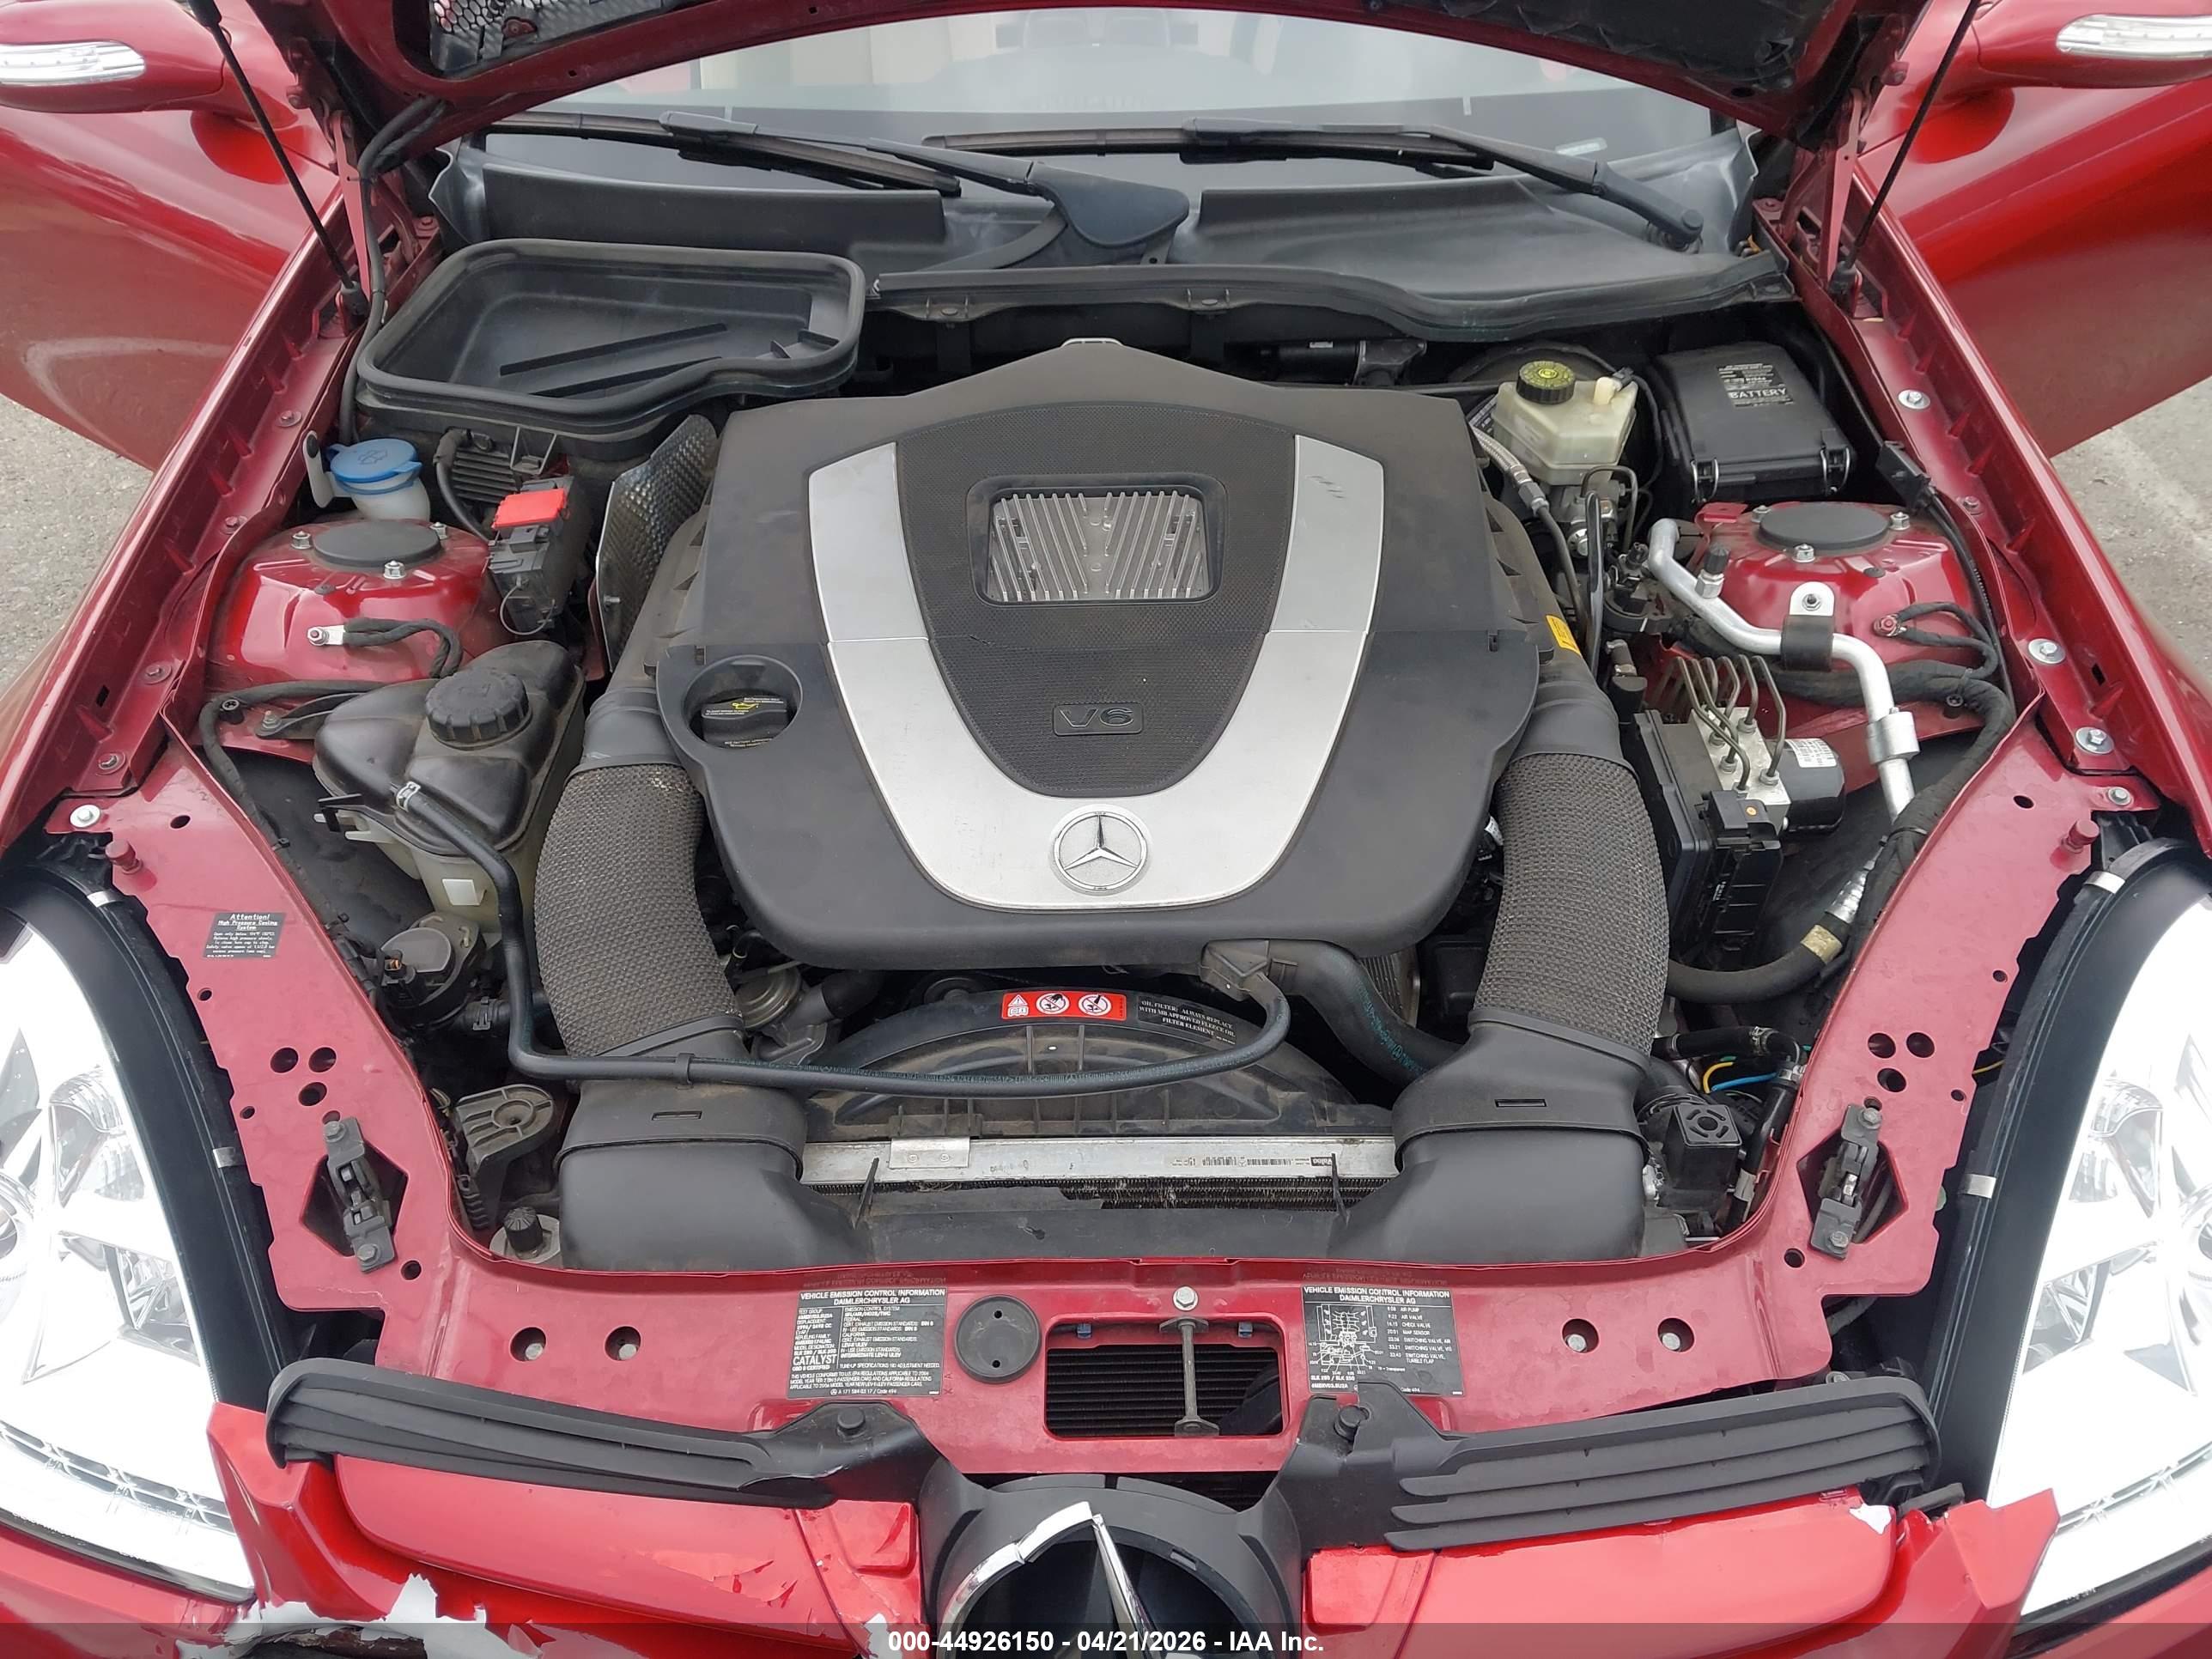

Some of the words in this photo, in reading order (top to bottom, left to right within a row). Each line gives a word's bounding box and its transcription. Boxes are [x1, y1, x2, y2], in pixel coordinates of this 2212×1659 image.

[1729, 388, 1786, 398] BATTERY
[1059, 707, 1134, 727] V6
[1169, 1012, 1200, 1024] APPROVED
[1201, 1019, 1224, 1032] FLEECE
[1182, 1009, 1206, 1019] ALWAYS
[1206, 1015, 1232, 1029] REPLACE
[1163, 1018, 1184, 1027] FILTER
[1186, 1023, 1214, 1036] ELEMENT
[800, 1291, 829, 1300] VEHICLE
[1340, 1295, 1405, 1304] DAIMLERCHRYSLER
[793, 1354, 837, 1365] CATALYST
